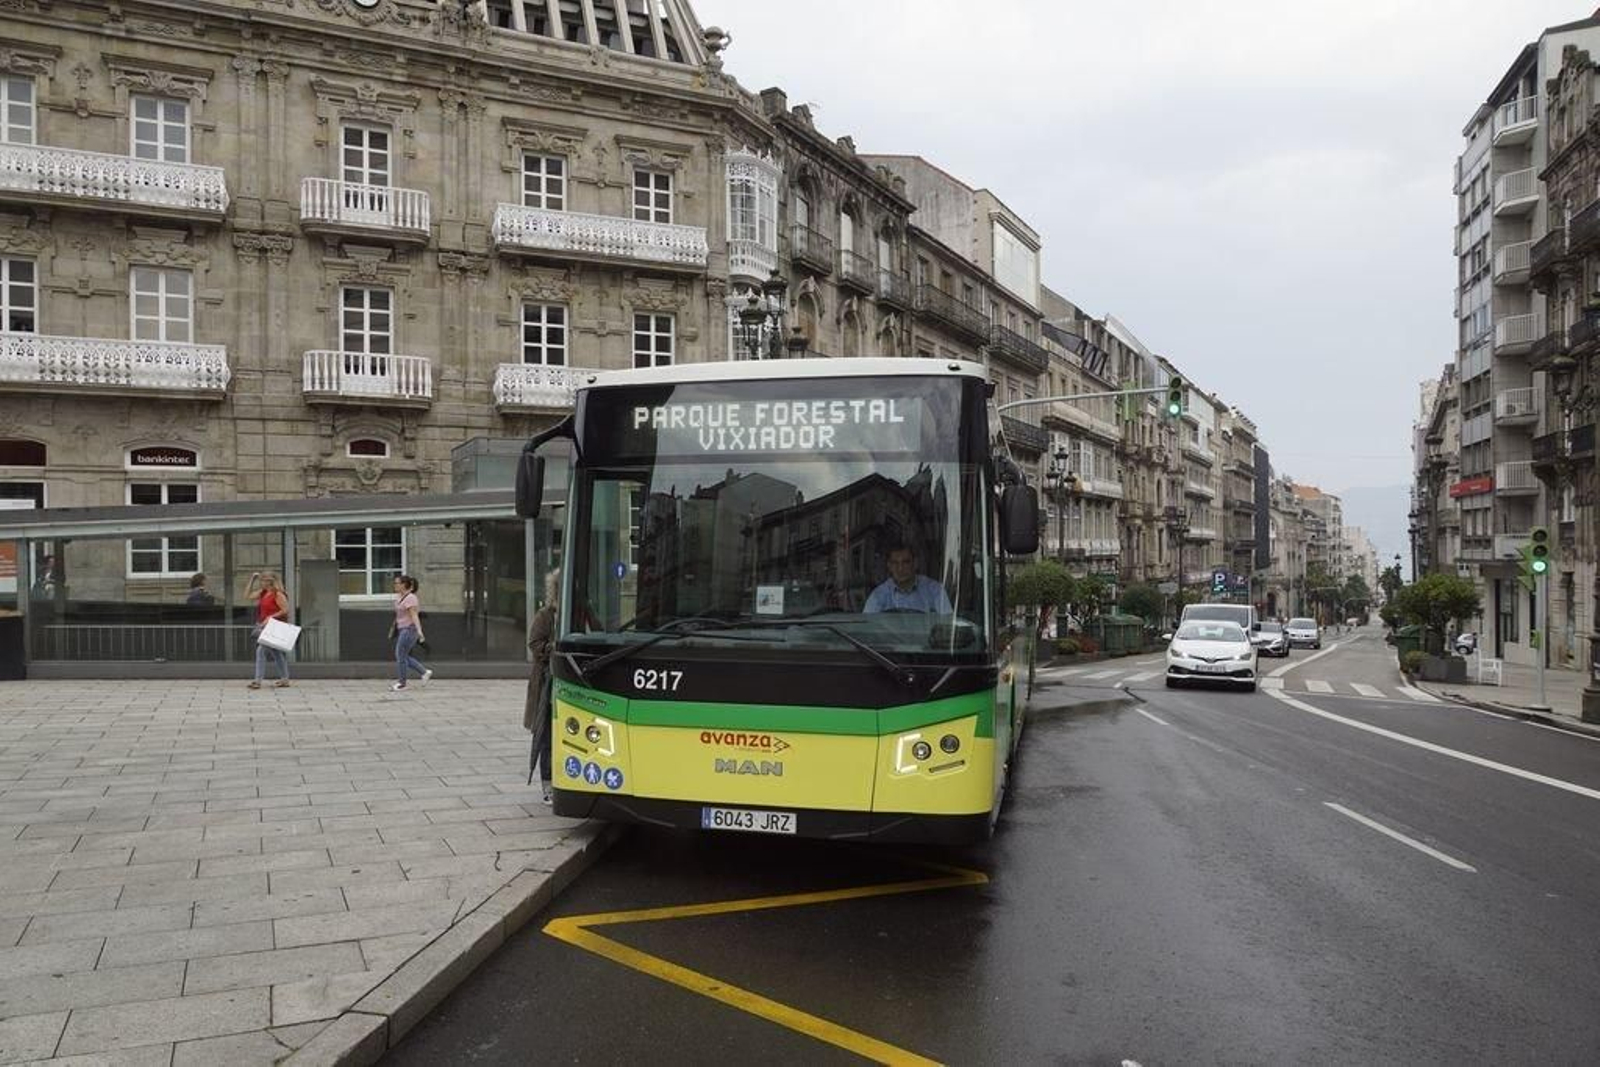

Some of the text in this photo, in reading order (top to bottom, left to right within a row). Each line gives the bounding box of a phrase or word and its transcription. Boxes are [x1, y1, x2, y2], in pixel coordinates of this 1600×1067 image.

[634, 399, 904, 429] PARQUE FORESTAL
[699, 425, 836, 450] VIXIADOR
[1214, 573, 1226, 585] P
[633, 669, 683, 691] 6217
[700, 731, 771, 748] avanza
[714, 758, 783, 776] MAN
[714, 810, 754, 829] 6043
[760, 813, 790, 832] JRZ
